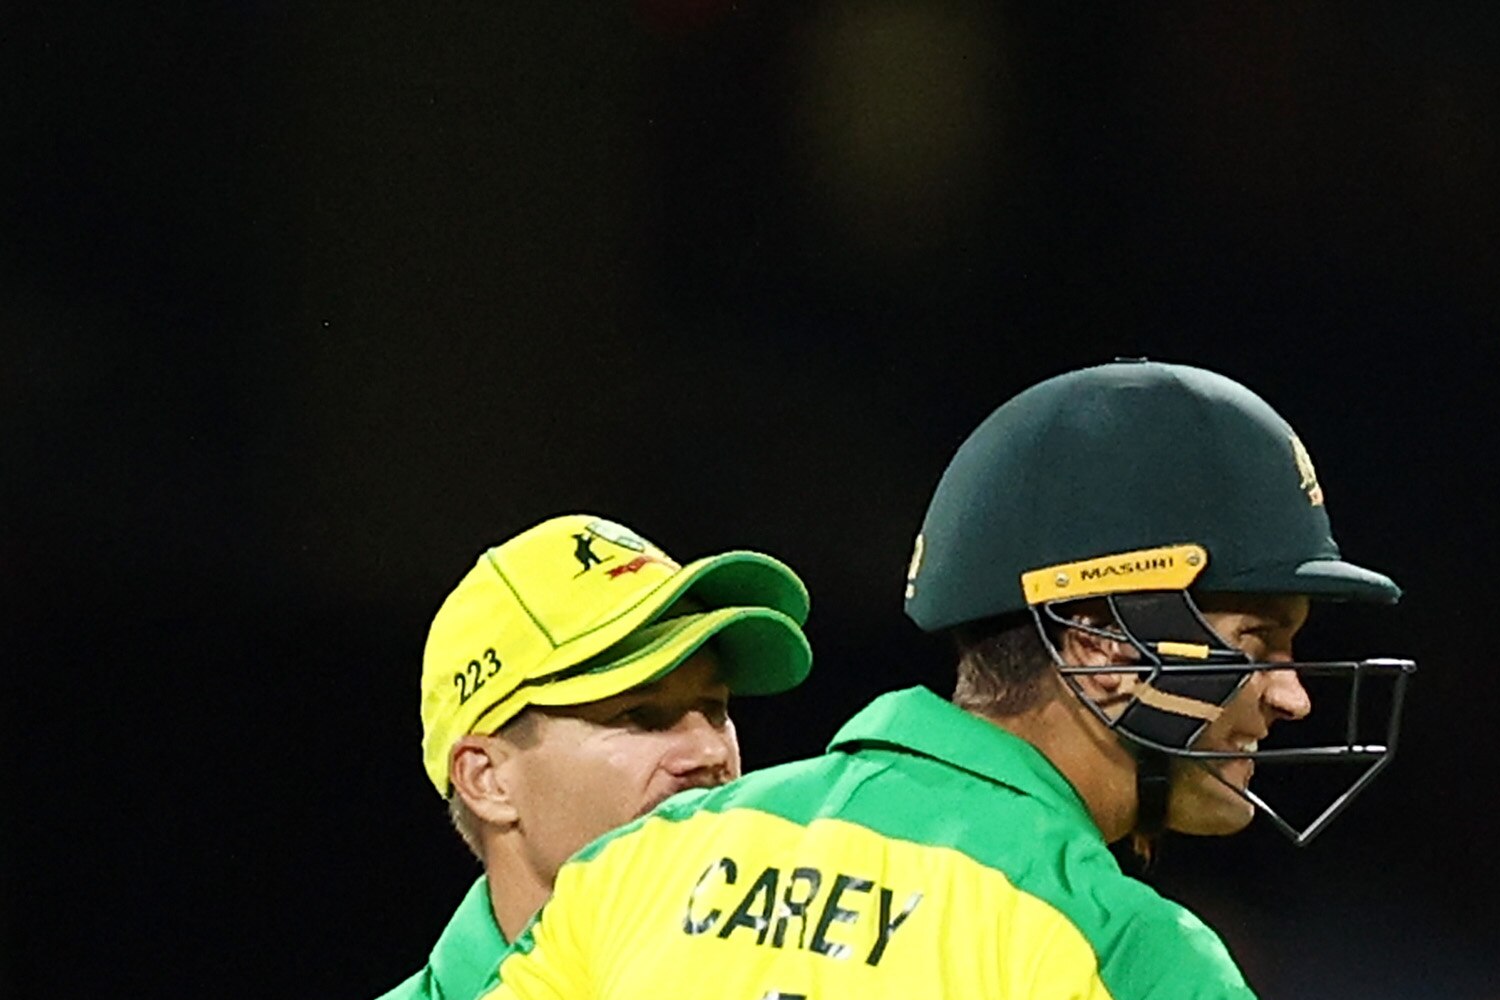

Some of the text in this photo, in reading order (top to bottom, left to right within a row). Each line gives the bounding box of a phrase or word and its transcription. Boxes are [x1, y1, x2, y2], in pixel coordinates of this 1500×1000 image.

[1080, 556, 1174, 581] MASURI
[453, 646, 503, 706] 223
[683, 857, 924, 967] CAREY
